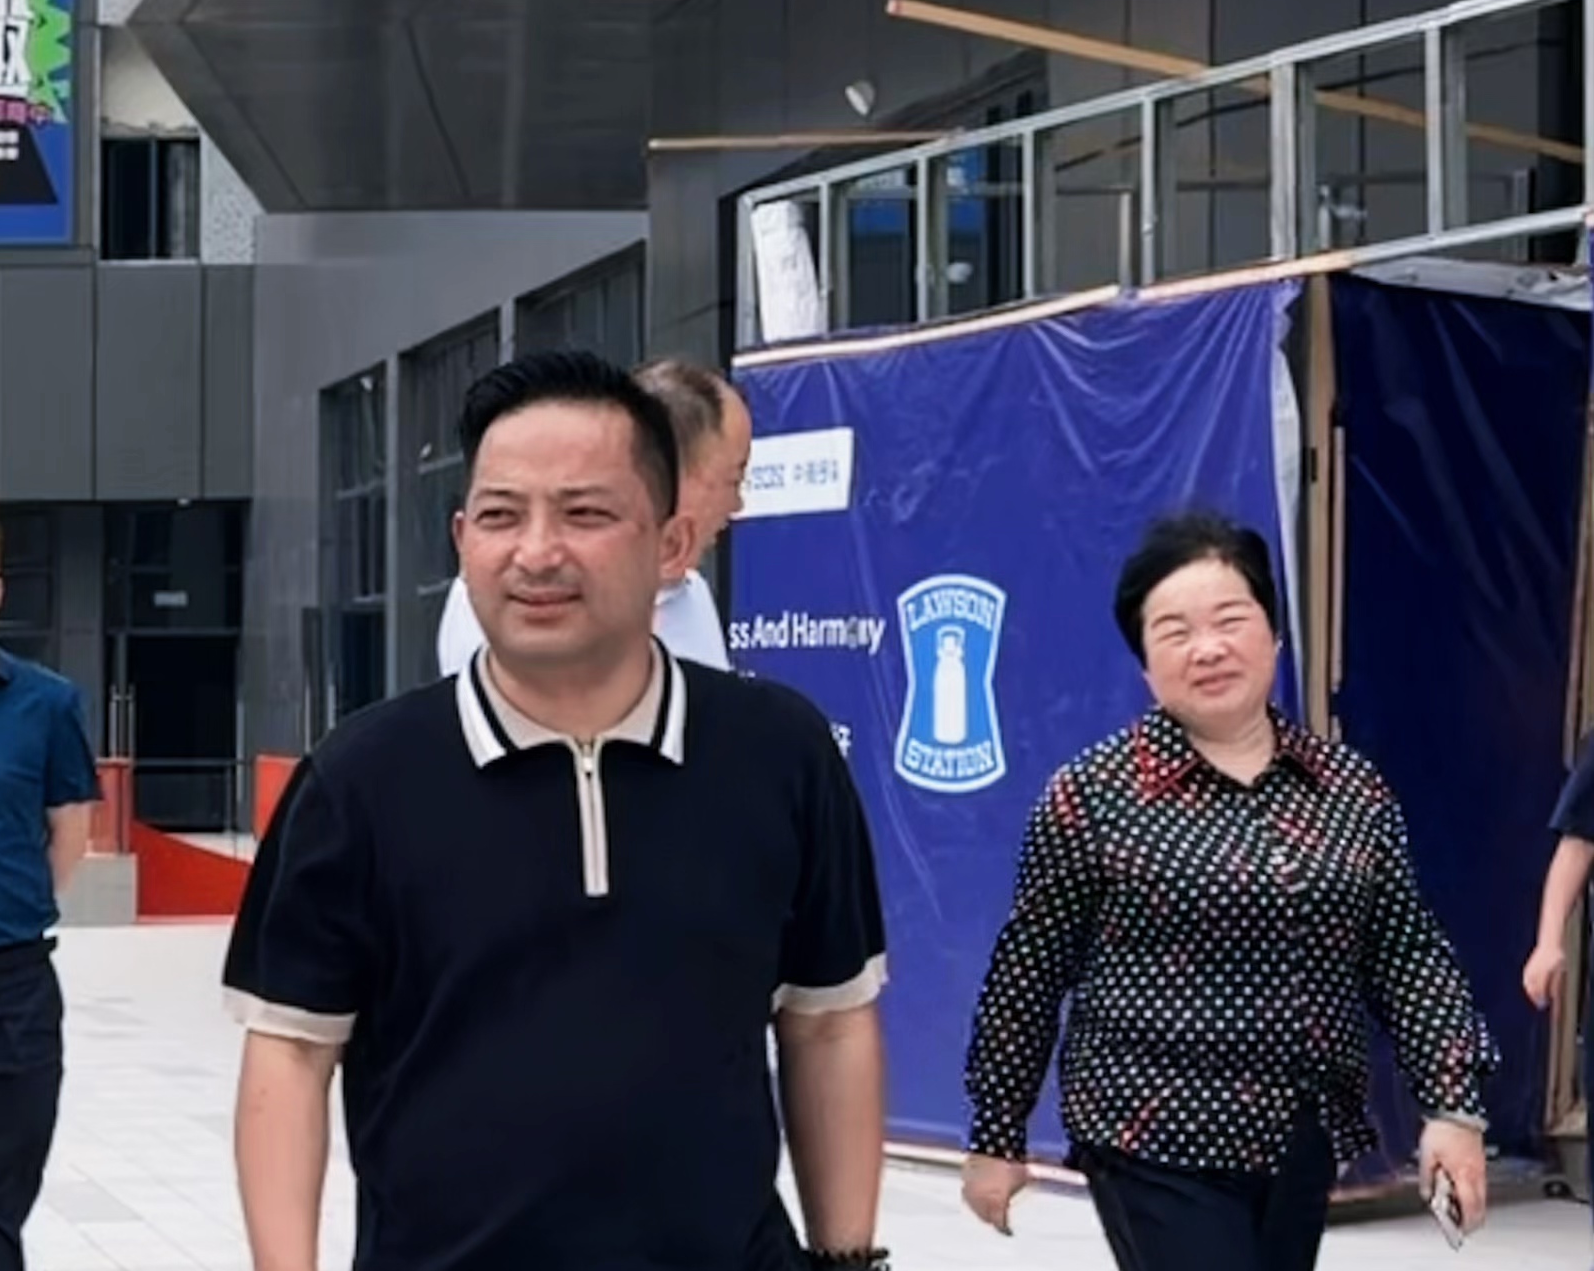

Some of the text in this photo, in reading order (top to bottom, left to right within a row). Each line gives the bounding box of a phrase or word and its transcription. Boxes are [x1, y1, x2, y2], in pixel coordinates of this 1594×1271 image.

[751, 611, 789, 648] And
[907, 587, 997, 631] LAWSON
[903, 737, 995, 778] STATION
